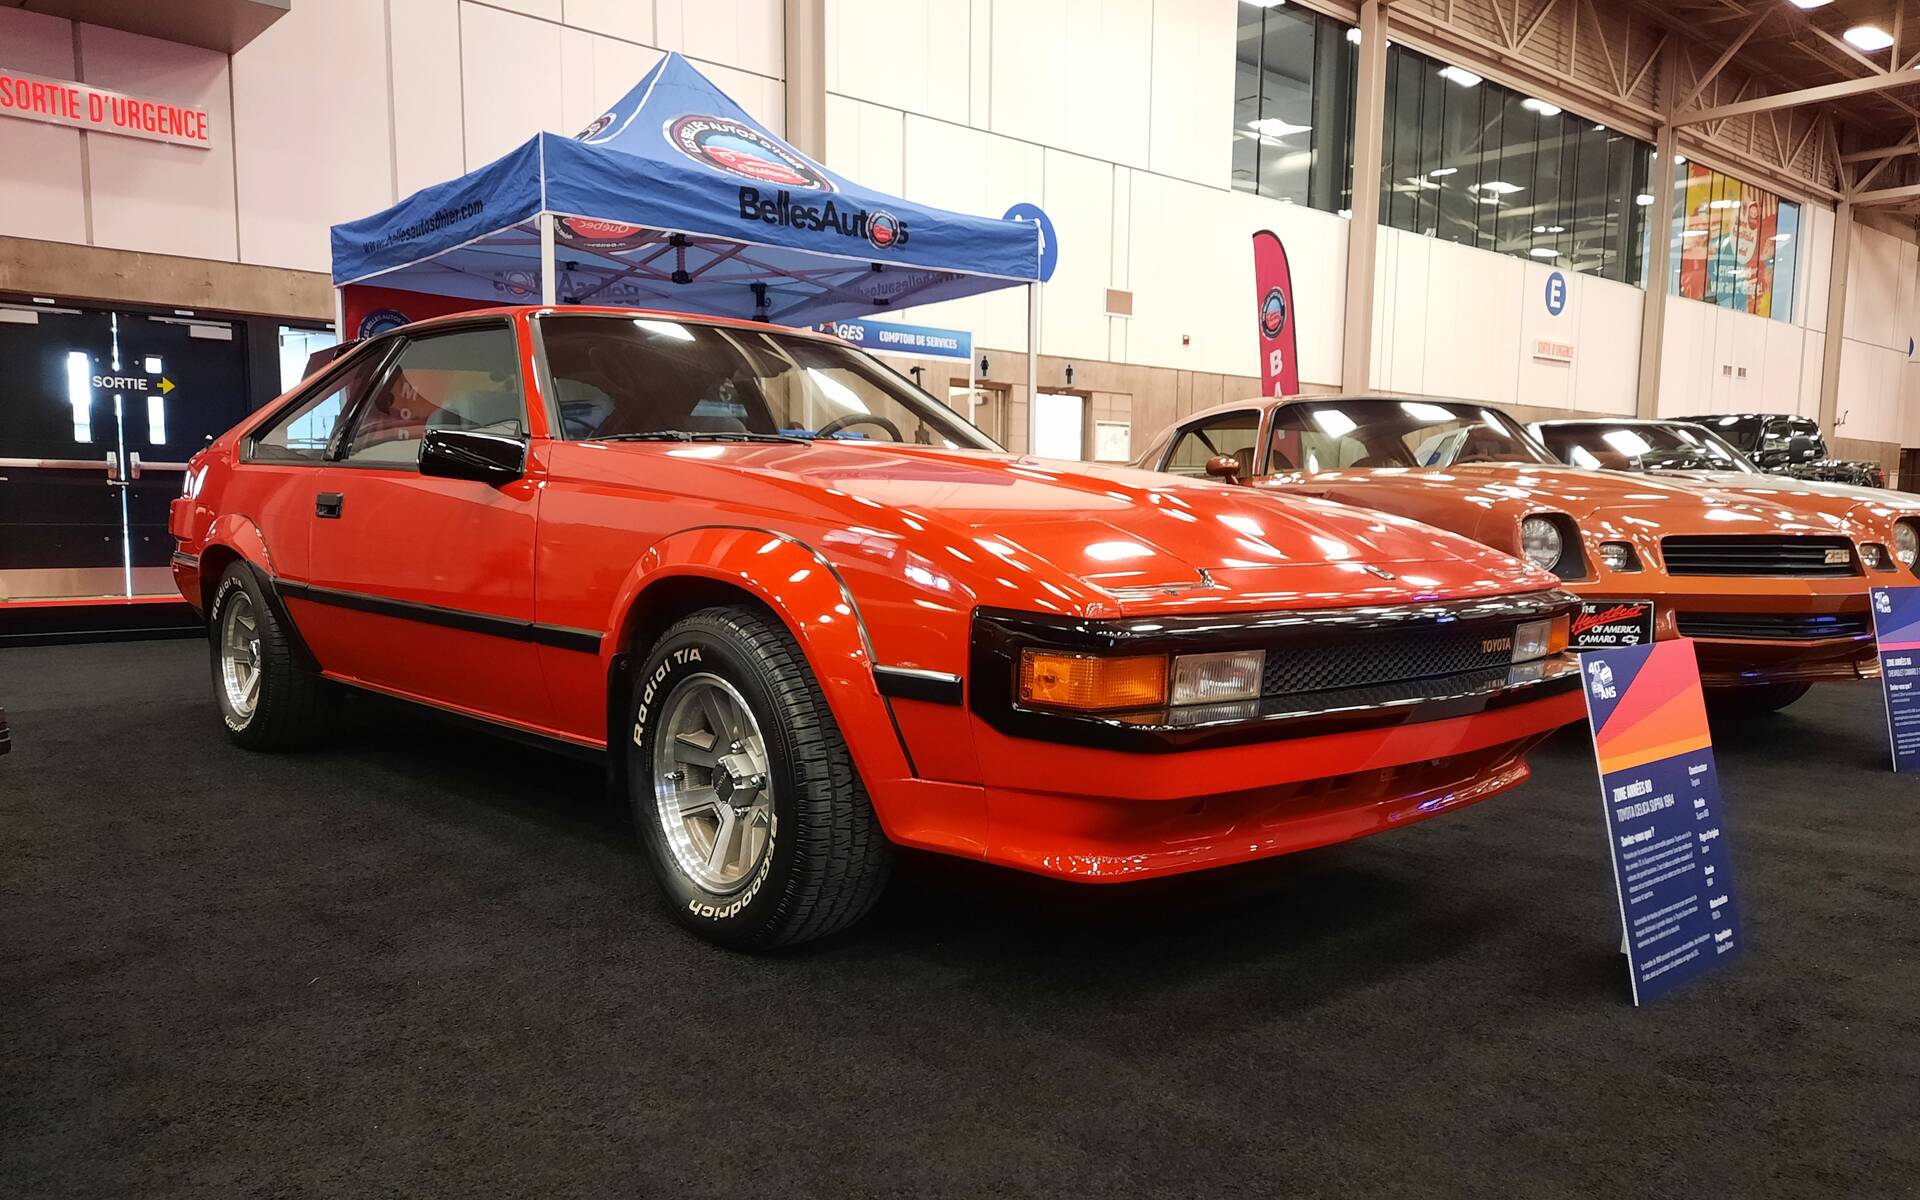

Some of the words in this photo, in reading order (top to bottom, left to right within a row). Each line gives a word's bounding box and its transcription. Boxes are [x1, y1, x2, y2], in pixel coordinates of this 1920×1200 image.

[0, 77, 81, 120] SORTIE
[88, 92, 208, 141] D'URGENCE
[709, 121, 758, 141] AUTOS
[1550, 279, 1562, 308] E
[879, 330, 915, 346] COMPTOIR
[916, 335, 927, 347] DE
[926, 336, 958, 350] SERVICES
[92, 375, 148, 391] SORTIE
[212, 577, 231, 620] Radial
[1581, 604, 1597, 614] THE
[1591, 625, 1605, 634] OF
[1603, 625, 1641, 634] AMERICA
[1482, 638, 1511, 654] TOYOTA
[1578, 634, 1617, 644] CAMARO
[1588, 660, 1601, 675] 40
[633, 658, 671, 747] Radial
[673, 647, 702, 664] T/A
[1601, 685, 1617, 700] ANS
[688, 812, 778, 922] BFGoodrich
